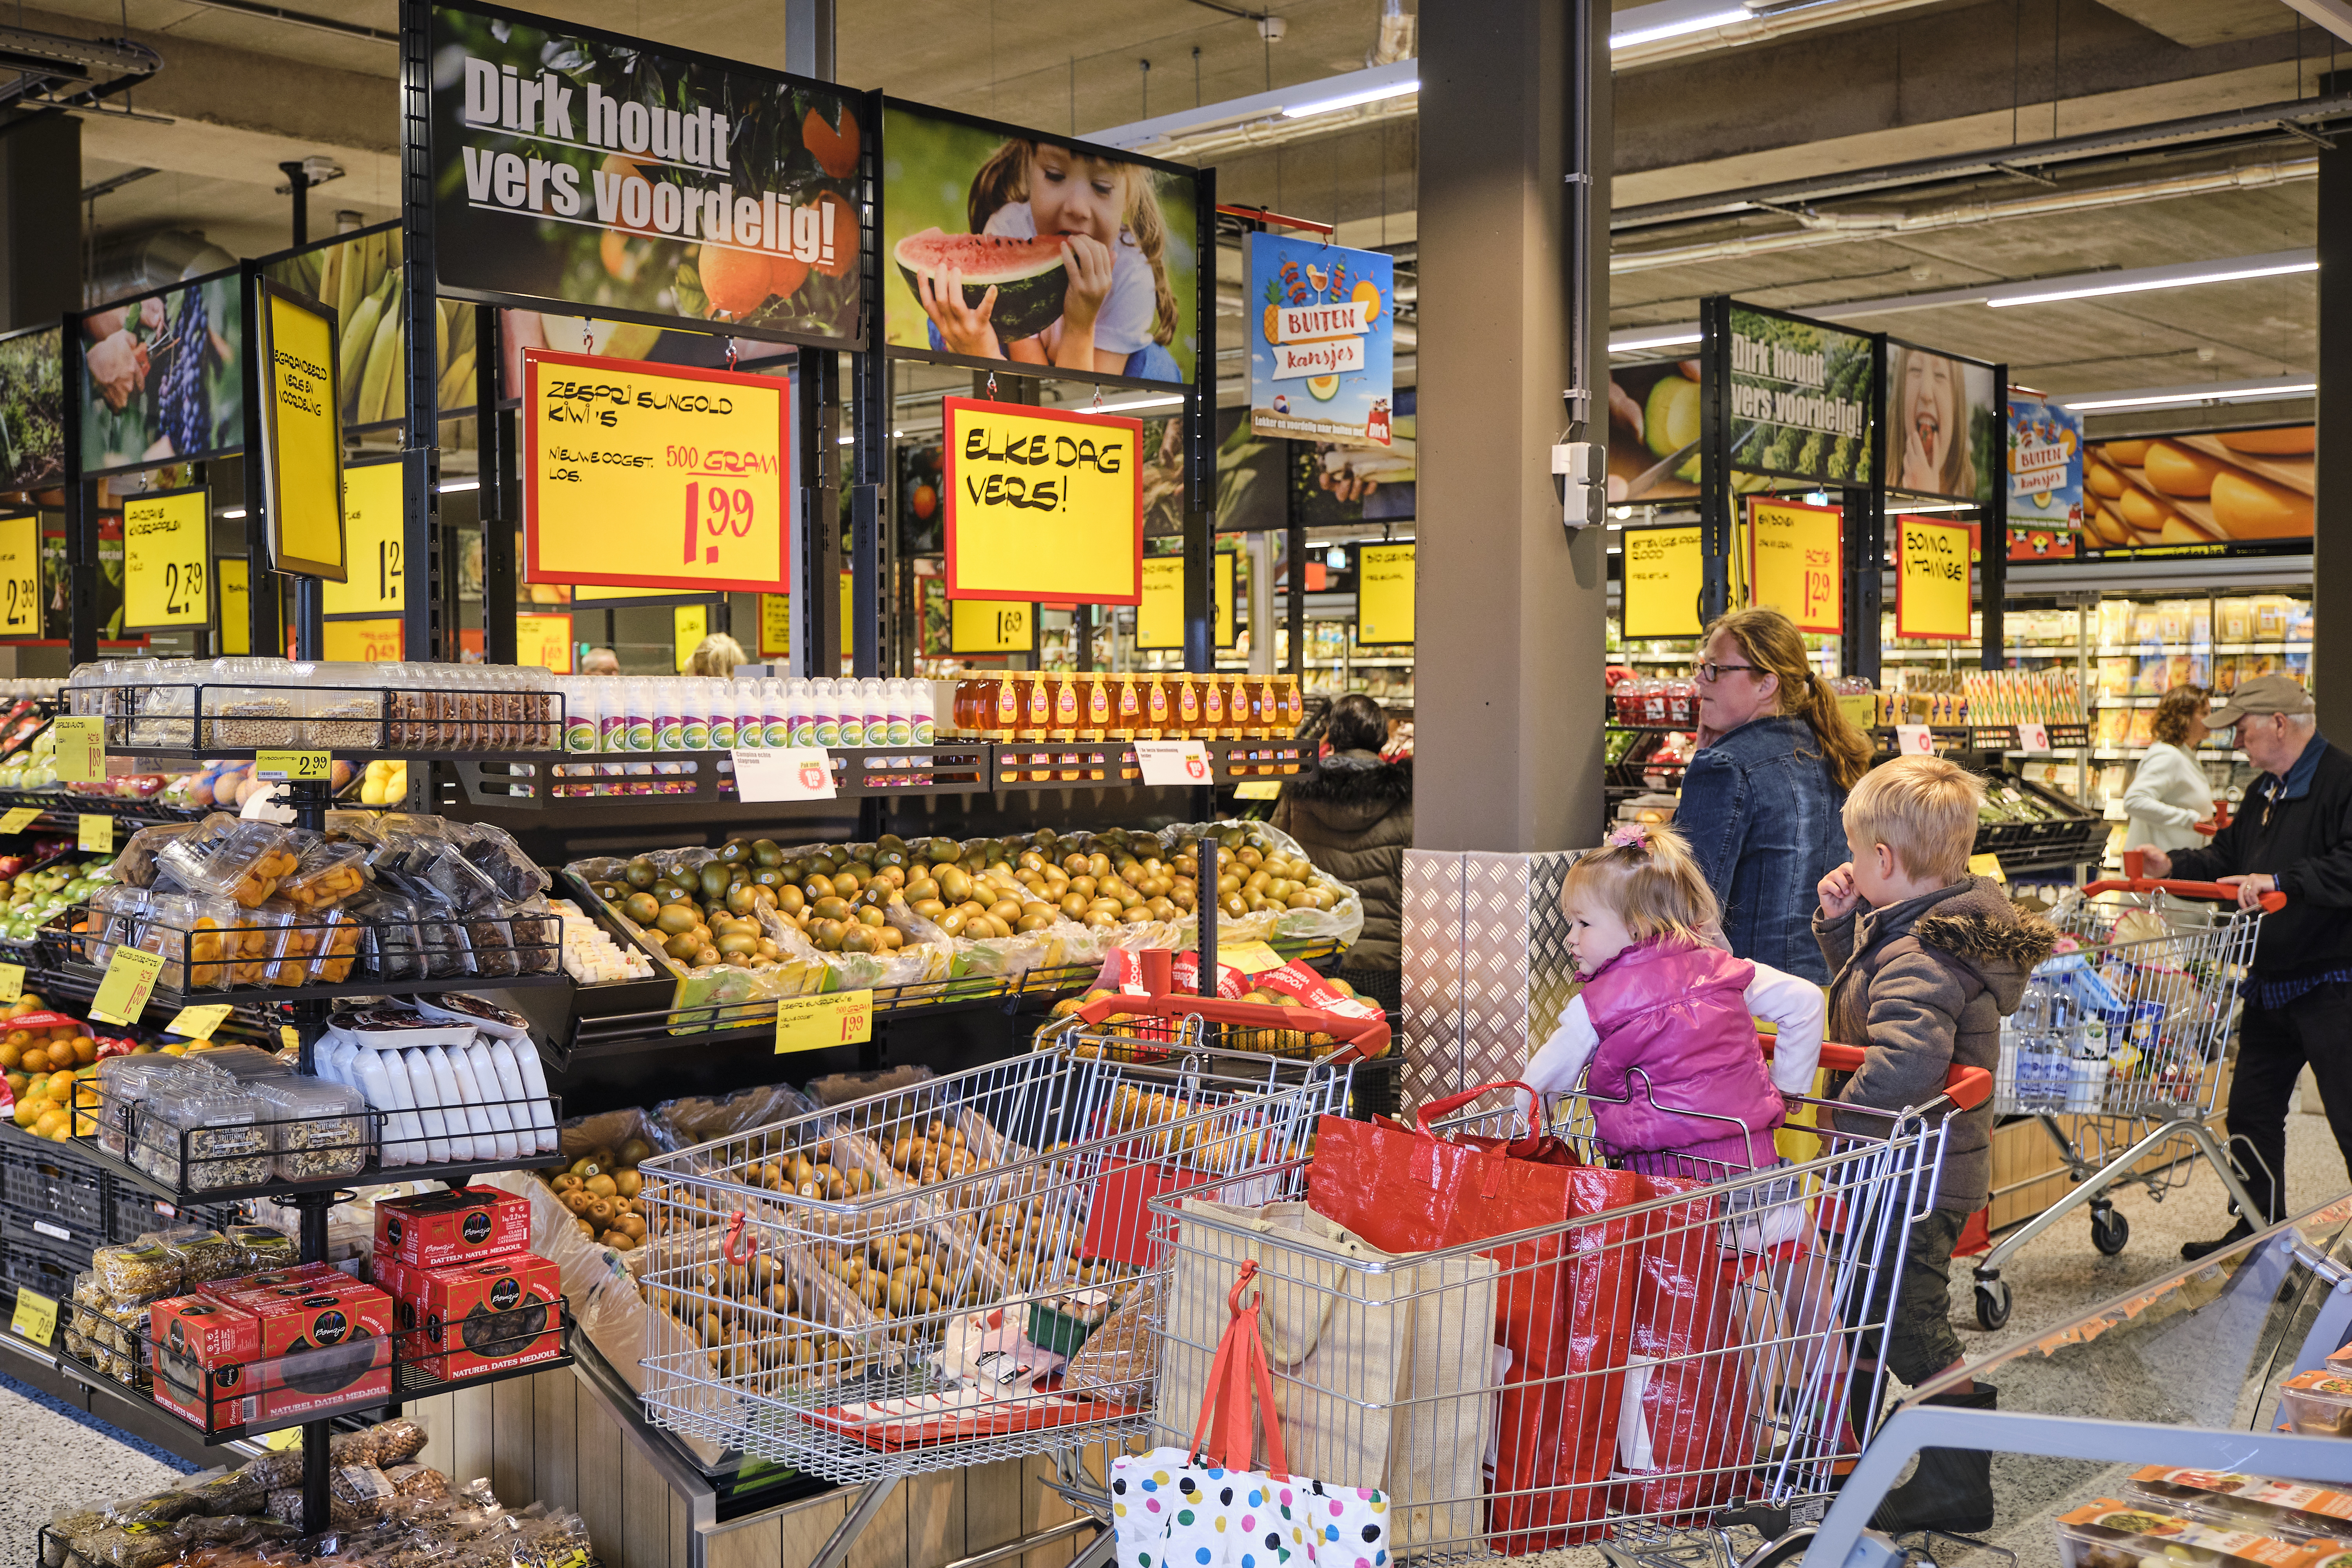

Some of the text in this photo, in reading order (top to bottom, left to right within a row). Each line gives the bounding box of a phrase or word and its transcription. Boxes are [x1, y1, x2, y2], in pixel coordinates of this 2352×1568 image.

[466, 56, 730, 170] Dirk houdt
[463, 146, 835, 263] vers voordelig!
[1289, 309, 1354, 333] BUITEN
[274, 350, 327, 380] EGARANDEERD
[1288, 343, 1353, 370] kansjes
[1732, 333, 1824, 387] Dirk houdt
[285, 374, 313, 394] VERS EN
[546, 381, 732, 414] ZESPRI SUNGOLD
[1731, 383, 1862, 439] vers voordelig!
[1369, 423, 1388, 439] Dirk
[550, 447, 599, 462] NIEUWE
[667, 445, 698, 467] 500
[704, 450, 777, 475] GRAM
[966, 427, 1122, 473] ELKE DAG
[2022, 448, 2061, 468] BUITEN
[967, 474, 1067, 512] VERS!
[380, 540, 404, 601] 1.2
[299, 756, 327, 775] 2.99
[221, 1131, 246, 1141] PITTENMIX
[384, 1207, 397, 1217] MEDJOUL
[464, 1227, 490, 1237] Bomaja
[425, 1243, 455, 1253] Bomaja
[431, 1243, 522, 1265] DATTELN NATUR MEDJOUL
[492, 1292, 519, 1304] Bomaja
[315, 1326, 345, 1337] Bomaja
[361, 1315, 380, 1328] NATUREL
[171, 1334, 185, 1348] Bomaja
[453, 1350, 557, 1378] NATUREL DATES MEDJOUL
[155, 1394, 205, 1428] NATUREL DATES MEDJOUL
[270, 1386, 388, 1416] NATUREL DATES MEDJOUL
